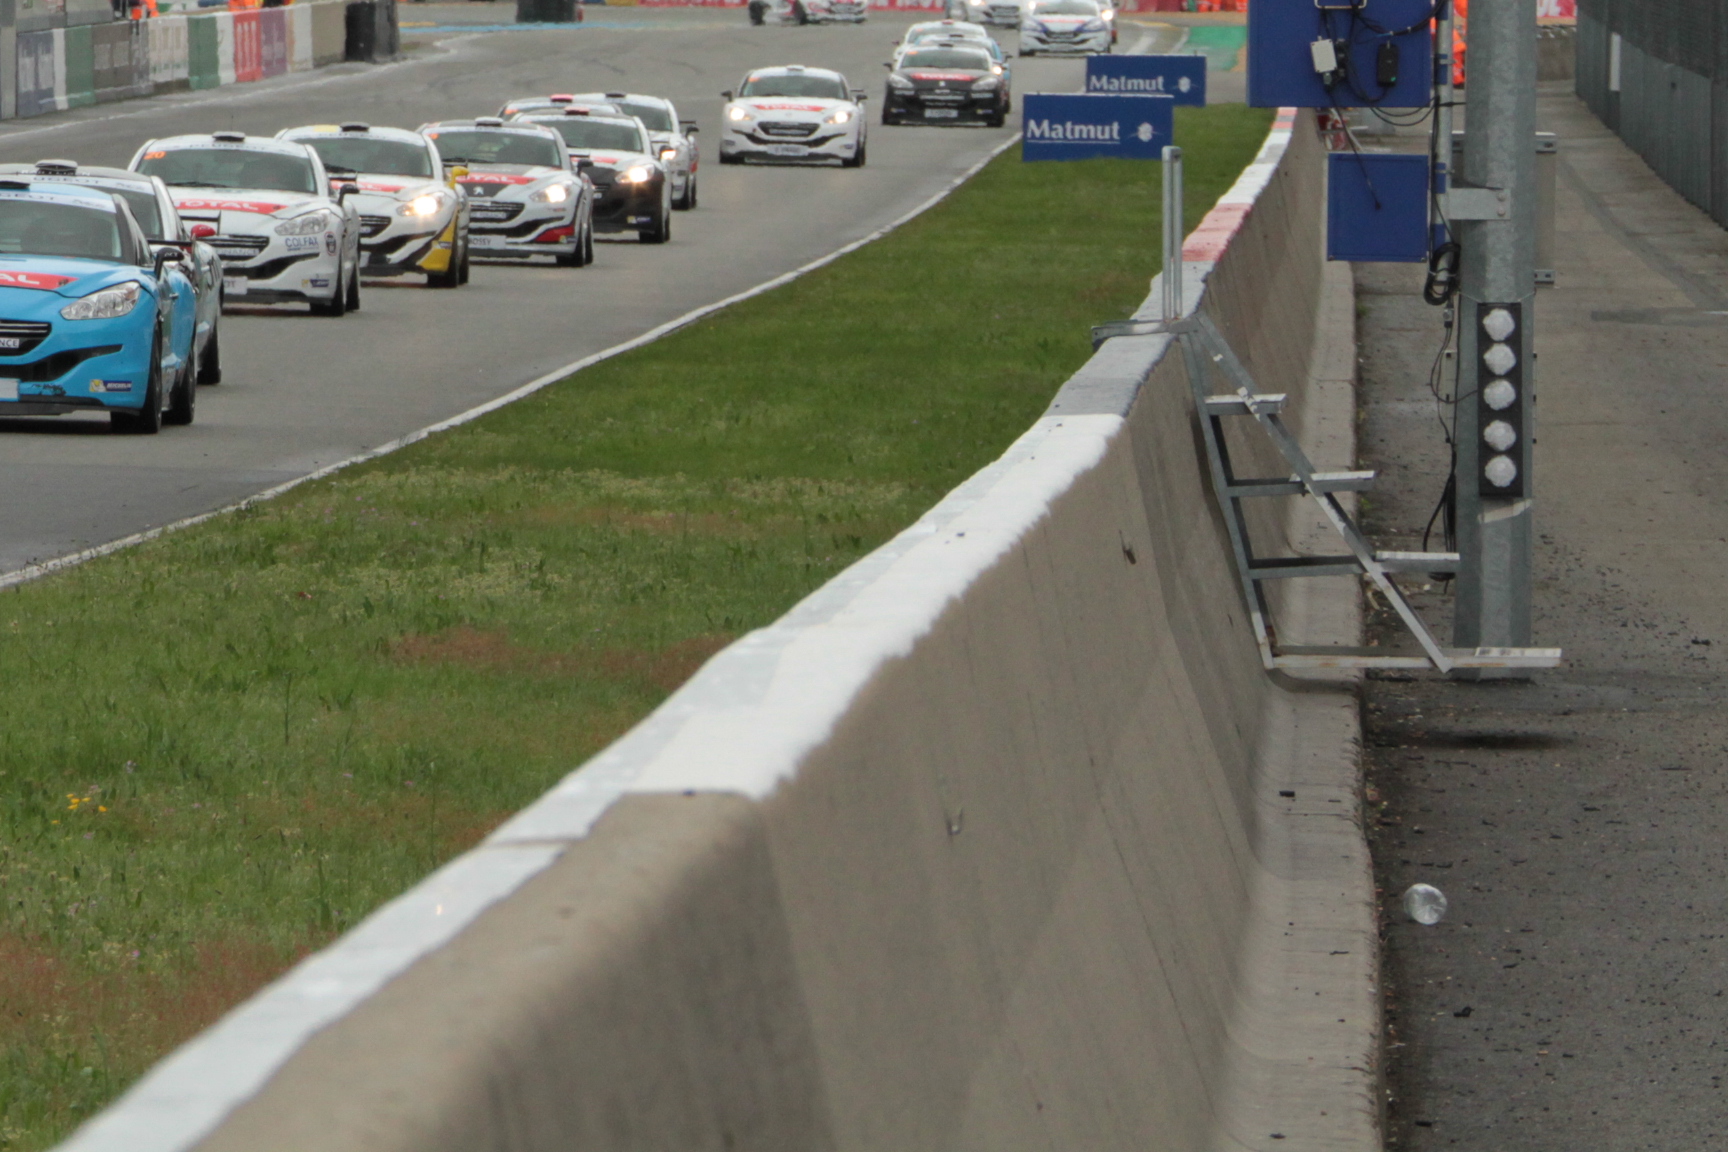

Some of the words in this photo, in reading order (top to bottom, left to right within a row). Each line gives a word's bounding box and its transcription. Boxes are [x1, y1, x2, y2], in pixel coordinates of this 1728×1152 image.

[1089, 74, 1165, 91] Matmut
[1027, 119, 1121, 140] Matmut
[144, 151, 167, 160] 20
[285, 237, 319, 248] COLFAX
